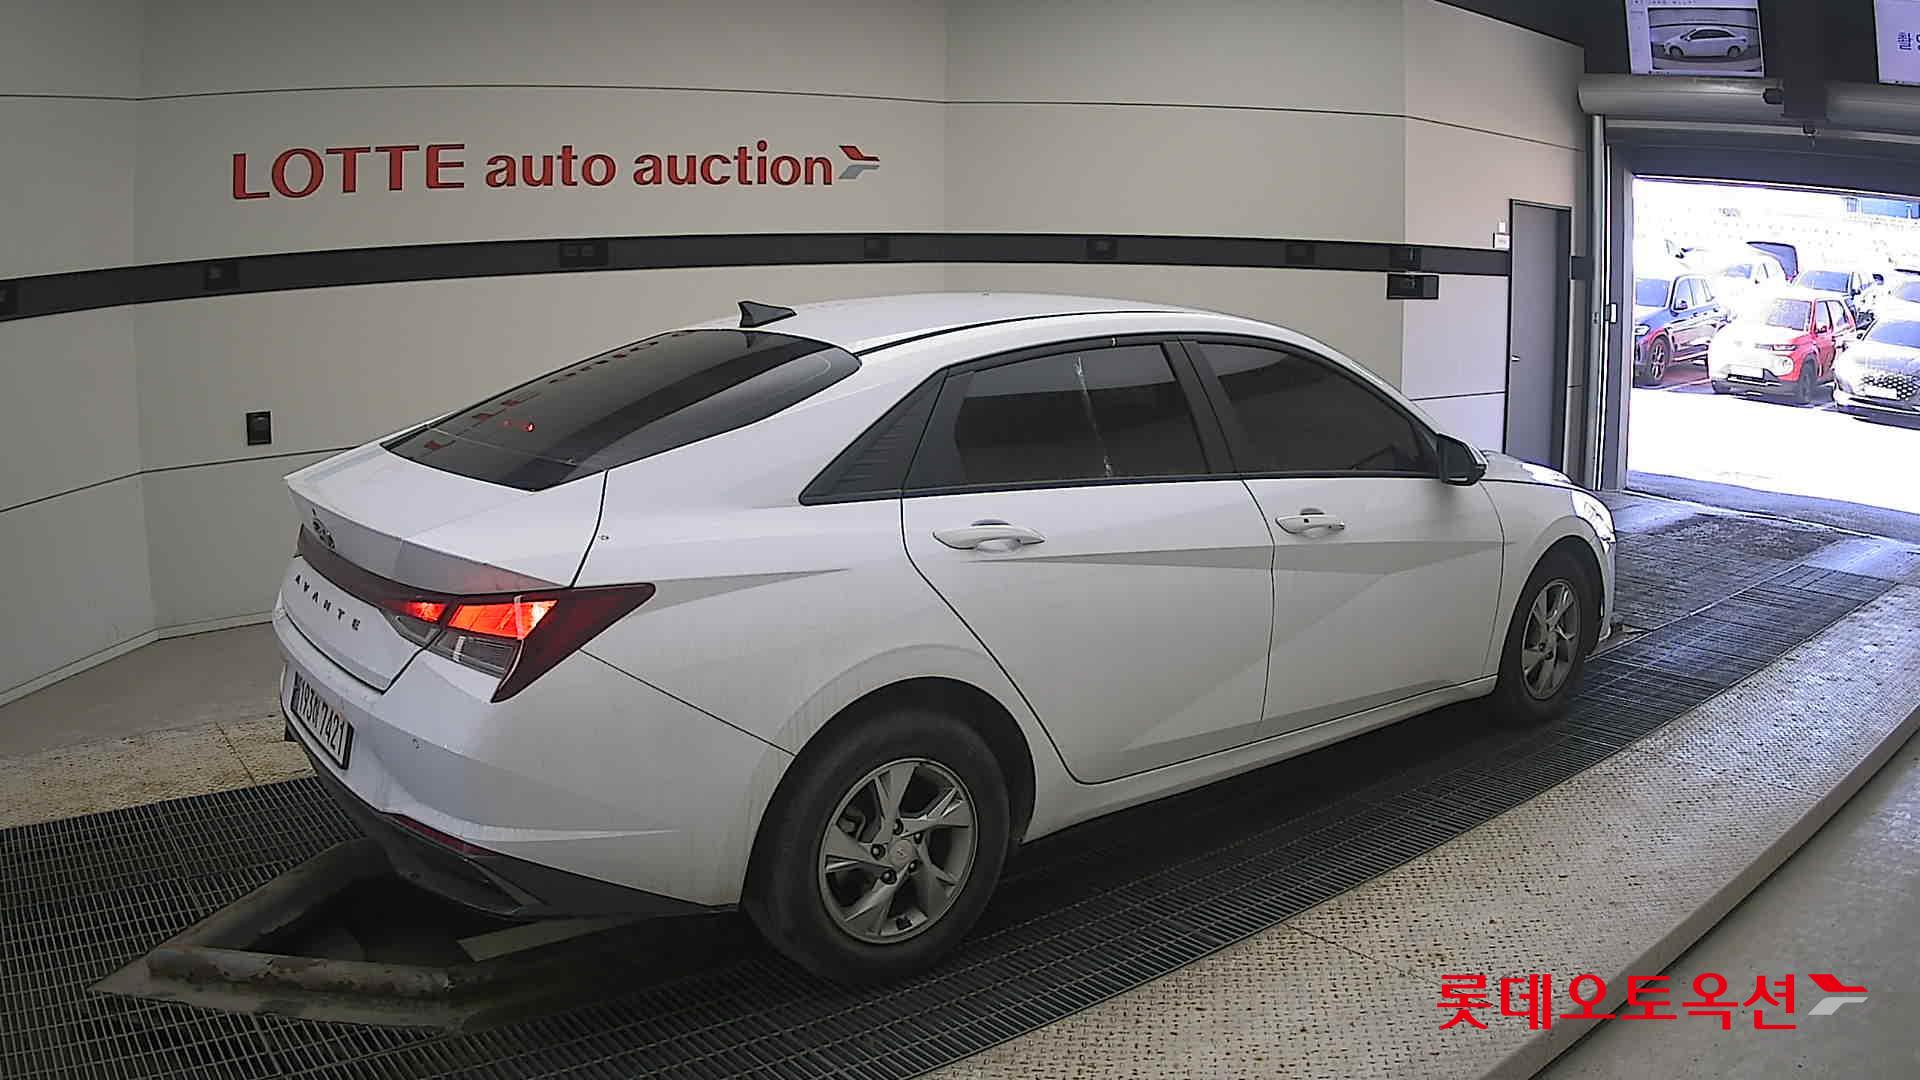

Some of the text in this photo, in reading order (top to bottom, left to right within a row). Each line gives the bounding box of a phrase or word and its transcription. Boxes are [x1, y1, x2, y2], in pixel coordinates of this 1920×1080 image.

[233, 139, 834, 199] LOTTE auto auction
[295, 574, 361, 631] AVANTE
